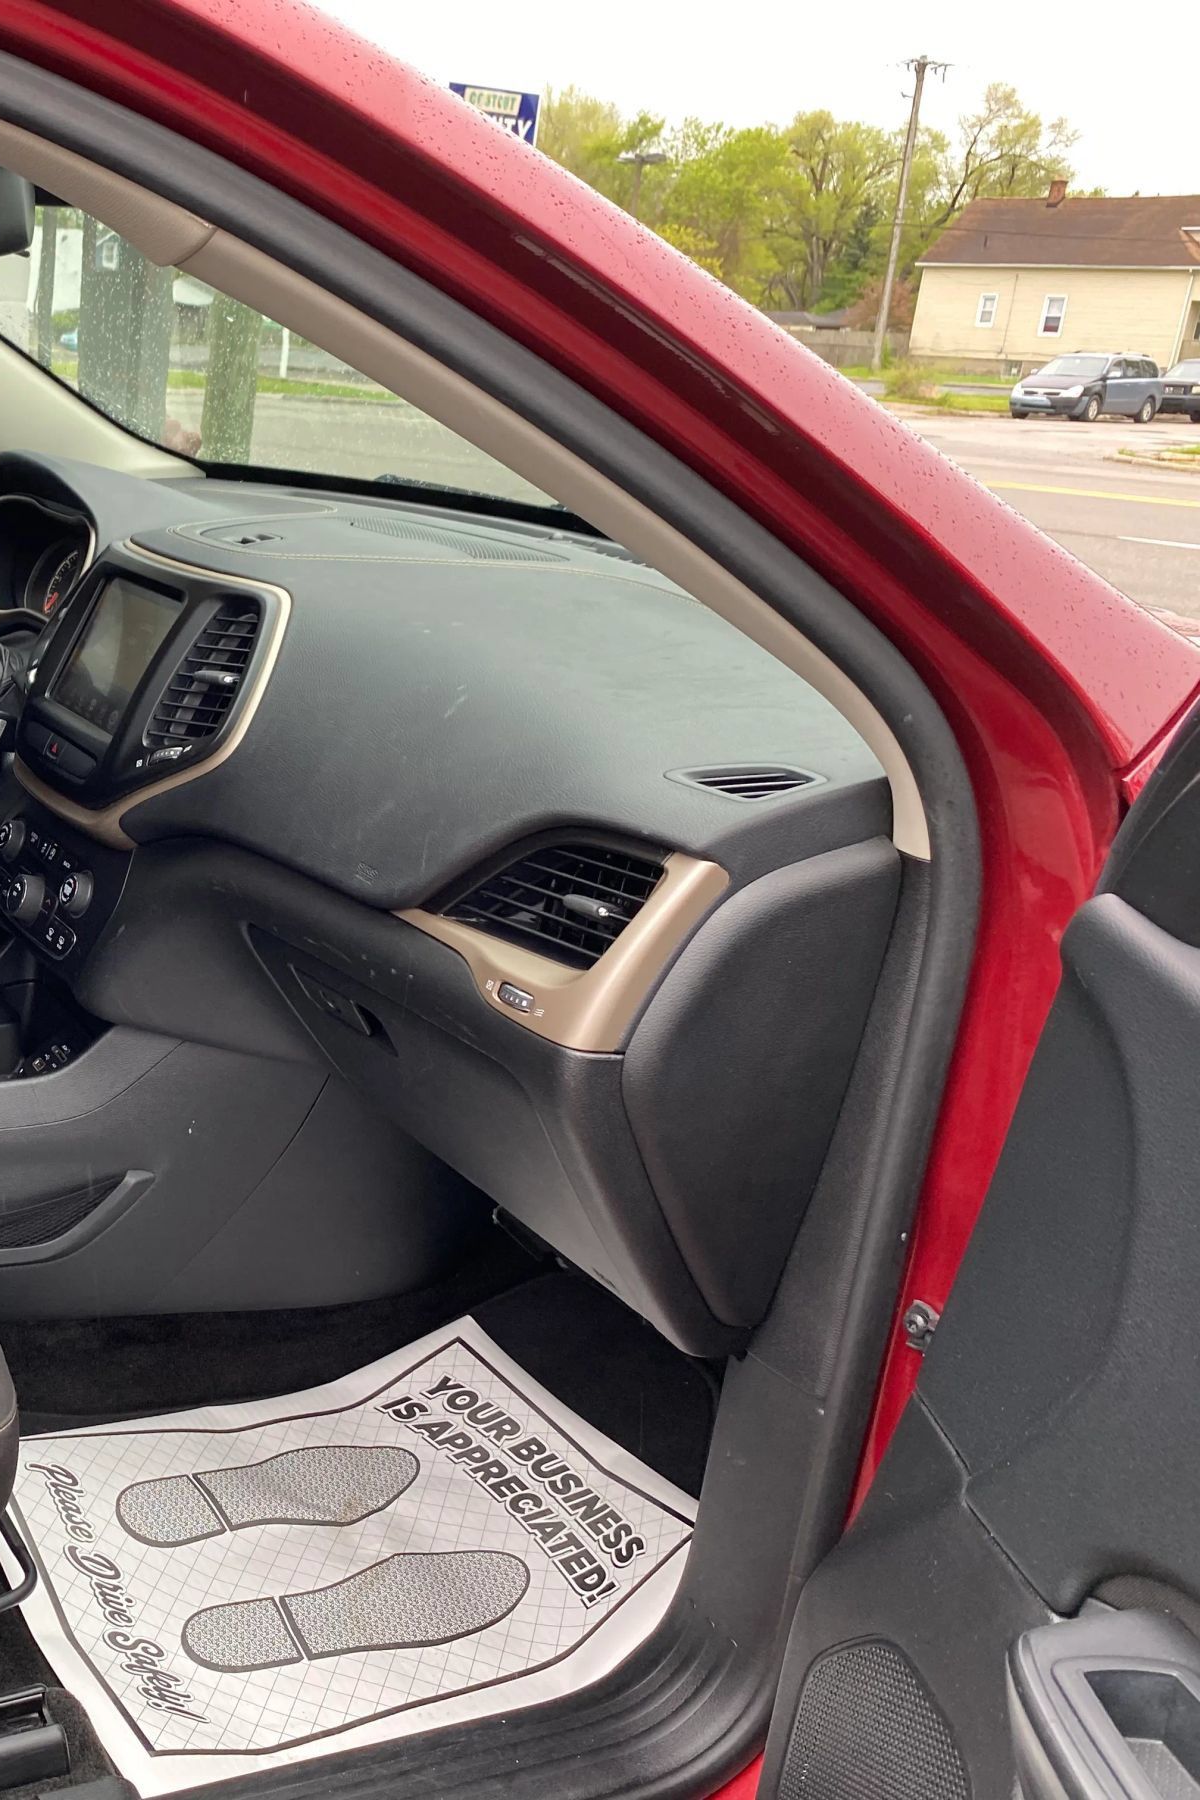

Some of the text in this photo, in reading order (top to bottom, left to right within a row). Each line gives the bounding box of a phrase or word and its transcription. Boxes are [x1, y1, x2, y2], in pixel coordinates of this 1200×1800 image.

[375, 1395, 621, 1608] IS APPRECIATED!
[421, 1373, 646, 1567] YOUR BUSINESS
[25, 1462, 212, 1724] Please Drive Safely!
